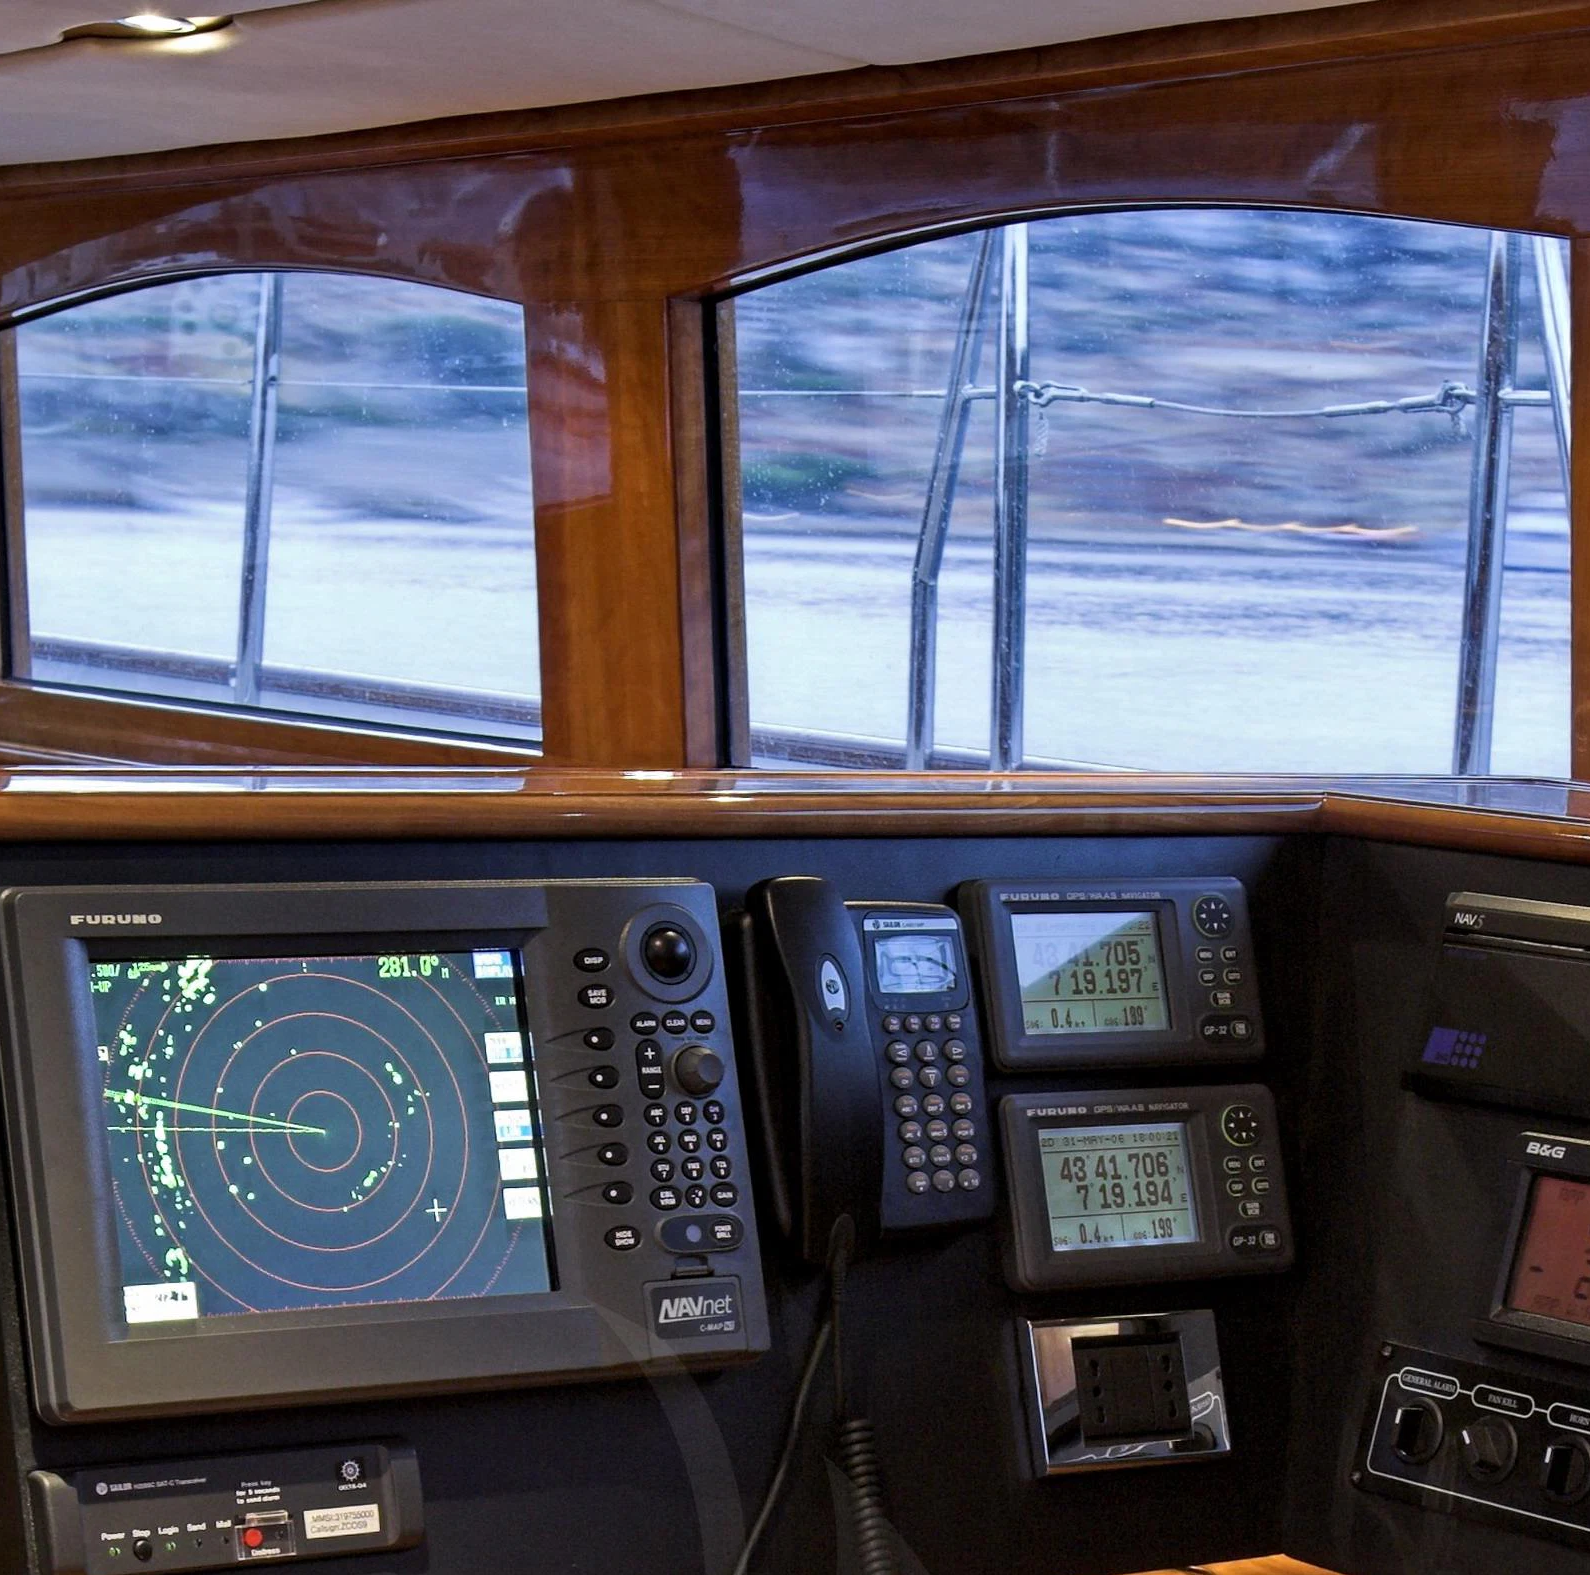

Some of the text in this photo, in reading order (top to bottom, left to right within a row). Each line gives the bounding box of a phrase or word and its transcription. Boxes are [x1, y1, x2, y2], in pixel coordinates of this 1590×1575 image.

[999, 892, 1060, 901] FURUNO
[70, 914, 162, 925] FURUNO
[584, 956, 604, 965] DISP
[587, 989, 607, 997] SAVE
[666, 1019, 686, 1027] CLEAR
[642, 1066, 662, 1074] RANGE
[1027, 1106, 1087, 1117] FURUNO
[1526, 1141, 1566, 1159] B&G
[615, 1231, 632, 1239] HIDE
[660, 1295, 732, 1321] NAVnet
[101, 1532, 125, 1541] Power
[132, 1529, 151, 1538] Stop
[158, 1526, 179, 1535] Login
[187, 1523, 207, 1532] Send
